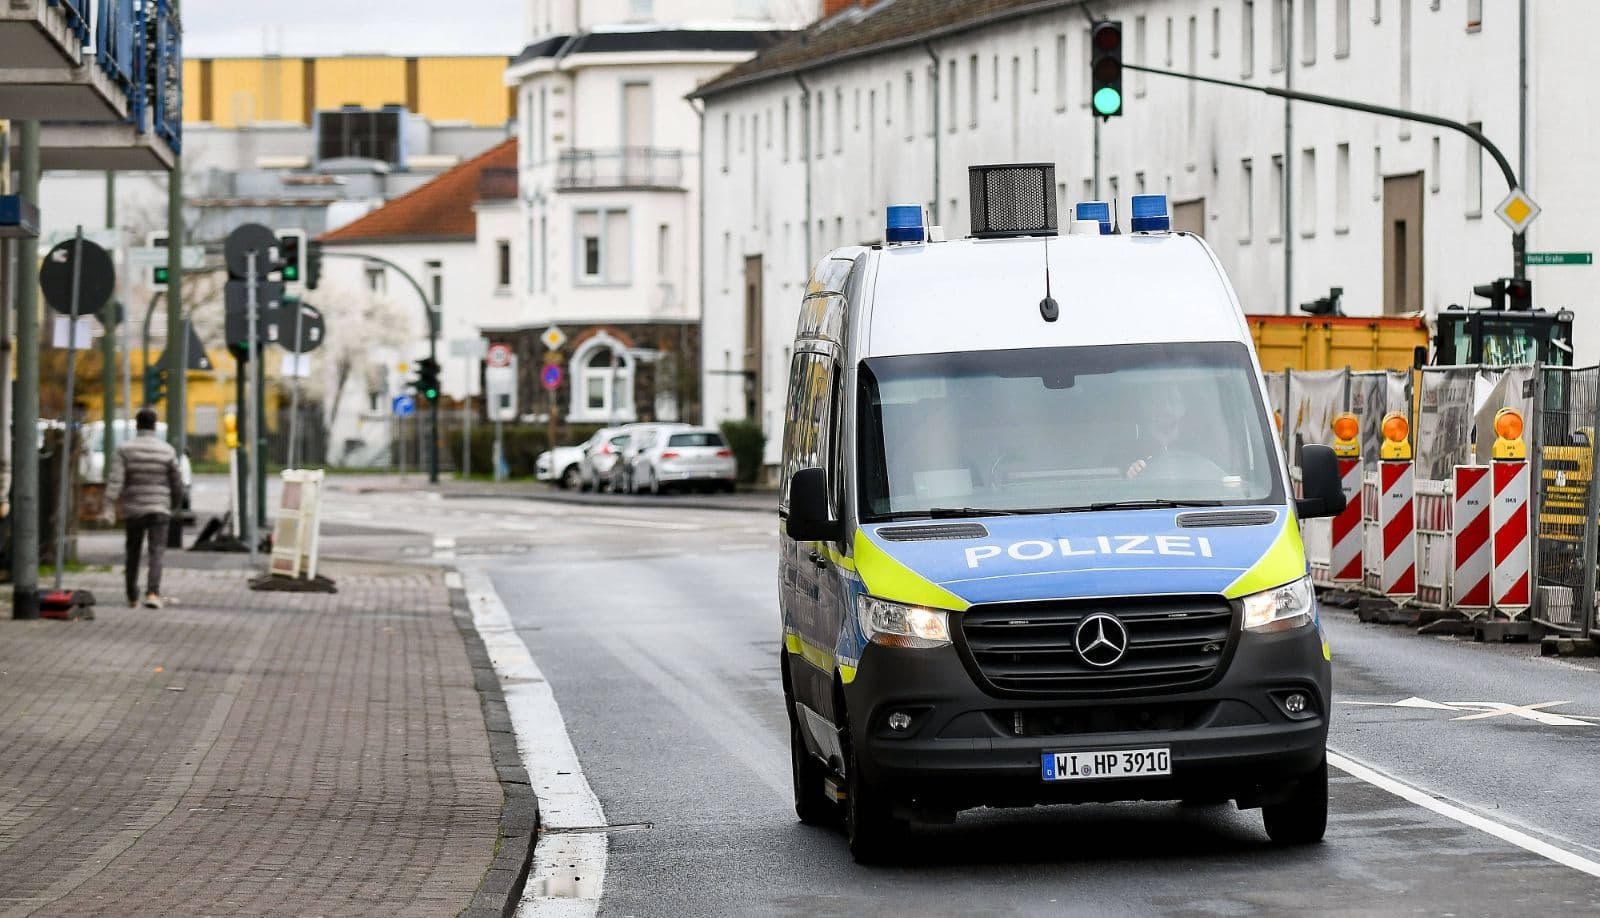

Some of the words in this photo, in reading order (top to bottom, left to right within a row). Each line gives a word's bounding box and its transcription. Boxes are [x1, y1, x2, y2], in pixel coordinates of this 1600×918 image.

[964, 535, 1213, 569] POLIZEI
[1057, 755, 1079, 776] WI
[1094, 754, 1118, 775] HP
[1122, 751, 1168, 773] 3910
